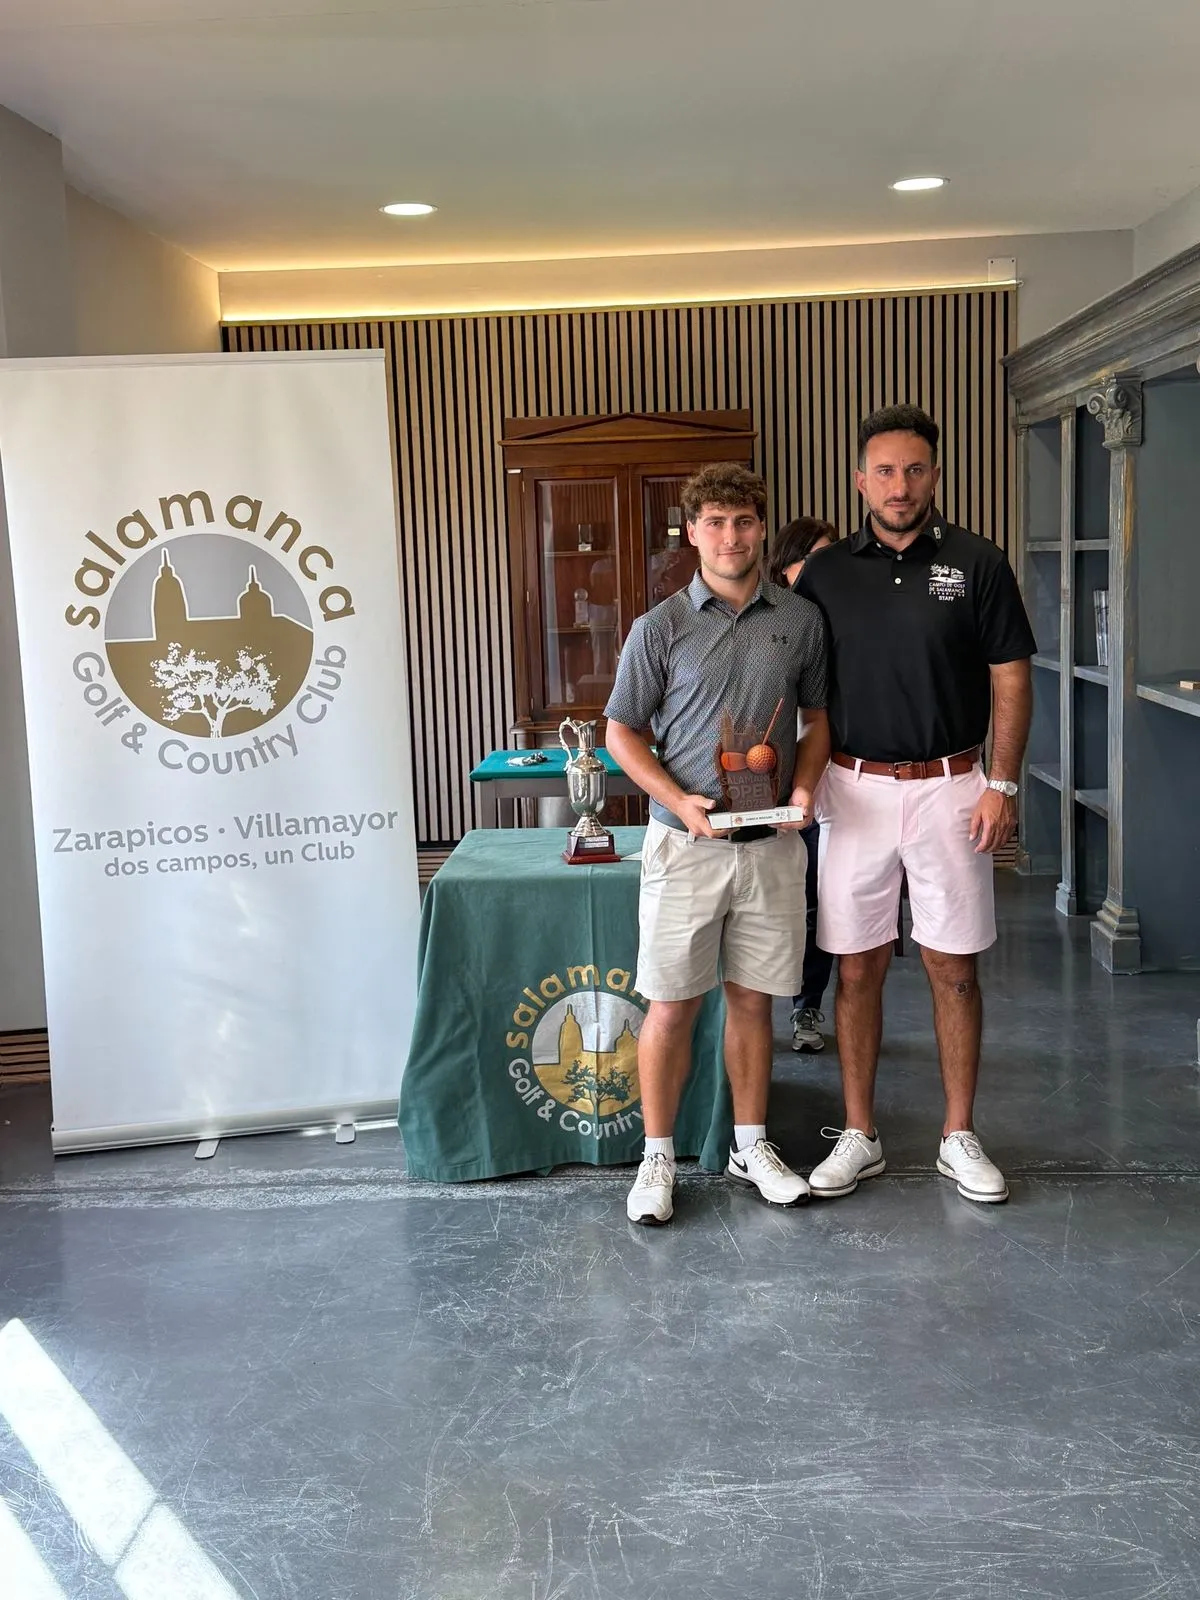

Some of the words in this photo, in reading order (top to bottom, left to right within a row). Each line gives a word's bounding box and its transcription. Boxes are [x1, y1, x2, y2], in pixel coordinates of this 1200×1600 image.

[65, 490, 355, 629] salamanca
[73, 652, 131, 727] Golf
[121, 722, 147, 754] &
[158, 724, 298, 774] Country
[296, 645, 347, 724] Club
[53, 821, 209, 852] Zarapicos
[233, 811, 398, 839] Villamayor
[104, 857, 149, 877] dos
[156, 852, 258, 874] campos,
[265, 849, 294, 865] un
[301, 841, 355, 862] Club
[506, 964, 650, 1049] salama
[508, 1058, 545, 1106] Golf
[537, 1099, 556, 1122] &
